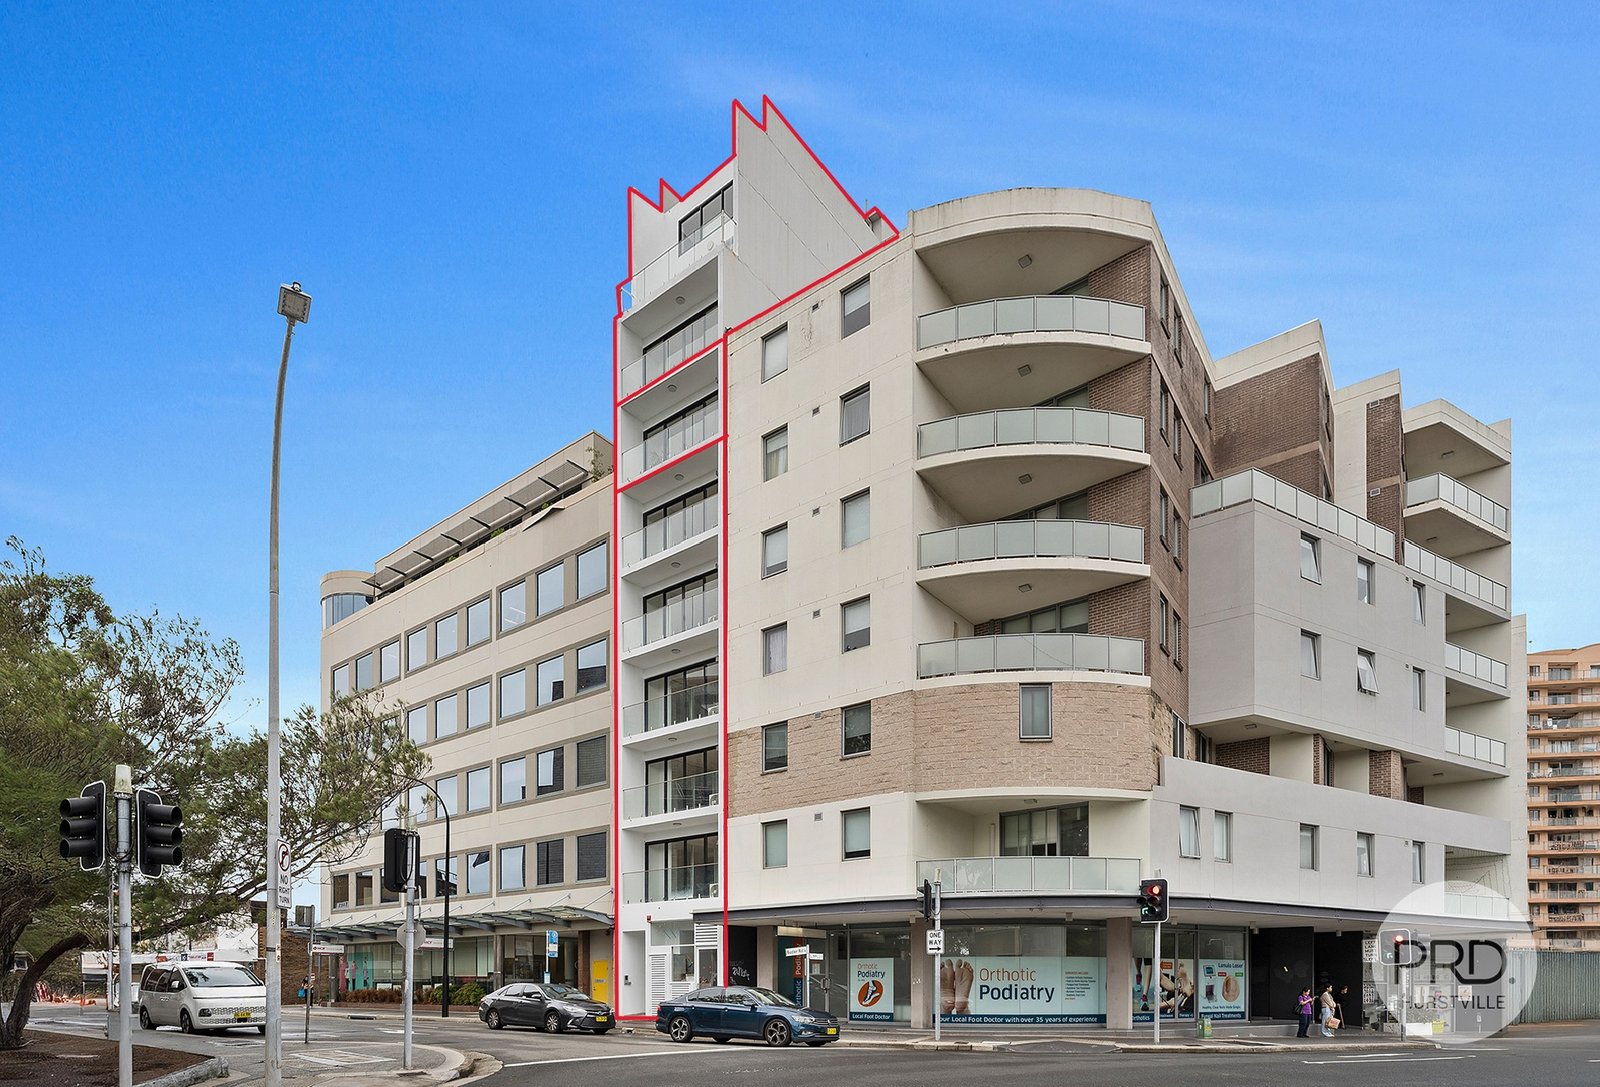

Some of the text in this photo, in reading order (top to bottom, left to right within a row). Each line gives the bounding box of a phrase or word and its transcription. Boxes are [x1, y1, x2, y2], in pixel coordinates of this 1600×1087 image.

[280, 874, 289, 885] NO
[279, 886, 290, 894] RIGHT
[279, 895, 290, 904] TURN
[858, 970, 886, 979] Podiatry
[979, 967, 1036, 982] Orthotic
[979, 984, 1055, 1003] Podiatry
